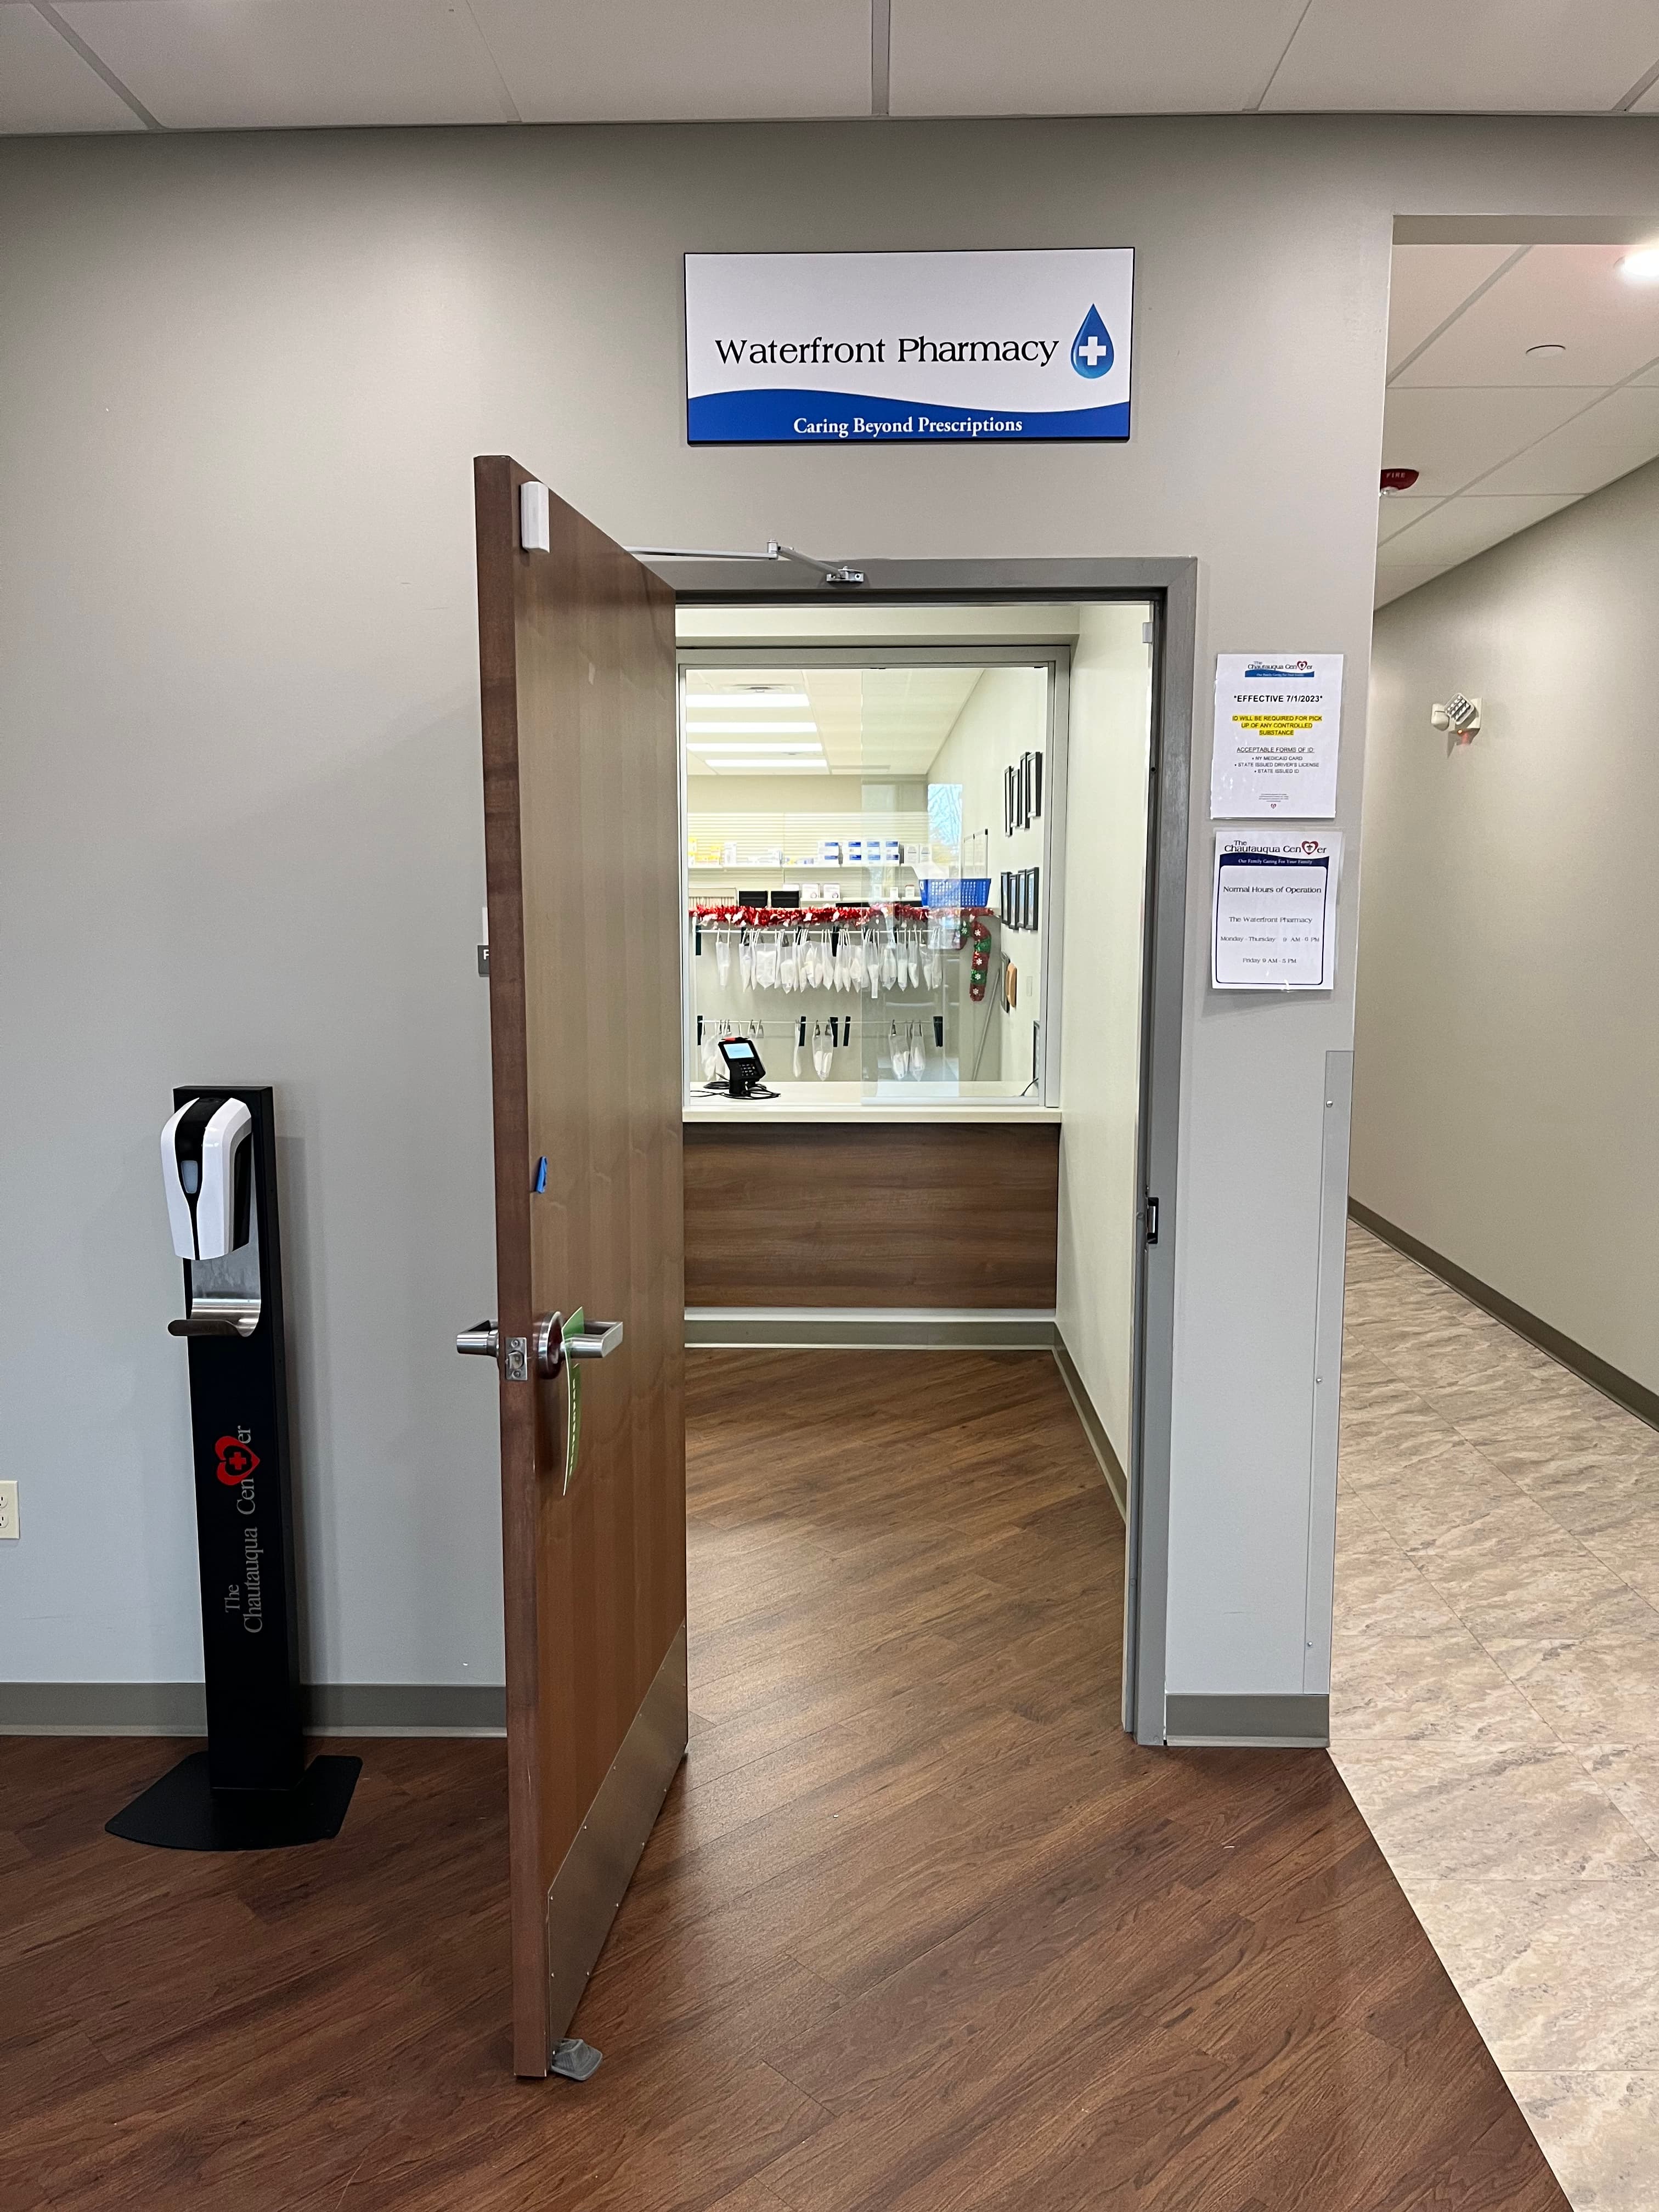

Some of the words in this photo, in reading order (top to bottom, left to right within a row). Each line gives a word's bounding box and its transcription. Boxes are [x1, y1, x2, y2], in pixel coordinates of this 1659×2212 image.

[714, 336, 885, 365] Waterfront
[898, 335, 1059, 366] Pharmacy
[793, 416, 849, 437] Caring
[853, 416, 914, 438] Beyond
[918, 415, 1023, 437] Prescriptions
[1224, 844, 1280, 854] Chautauqua
[242, 1526, 264, 1634] Chautauqua
[225, 1584, 240, 1613] The
